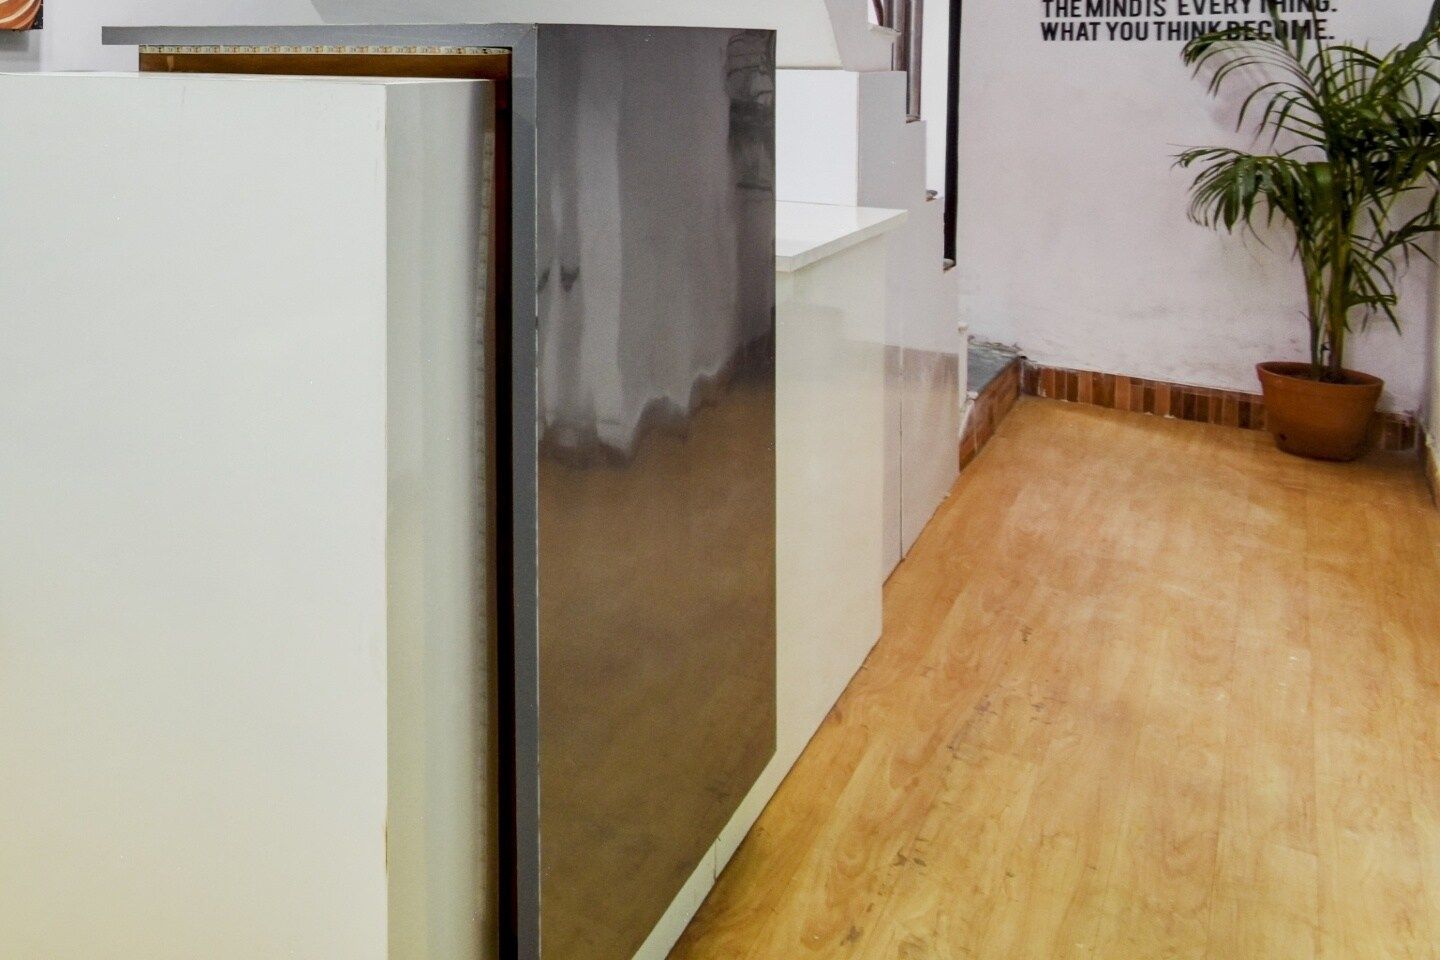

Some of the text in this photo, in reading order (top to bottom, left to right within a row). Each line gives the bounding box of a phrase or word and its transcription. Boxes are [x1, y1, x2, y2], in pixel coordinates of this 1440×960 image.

[1042, 0, 1082, 18] THE
[1040, 22, 1101, 41] WHAT
[1106, 21, 1149, 41] YOU
[1153, 20, 1221, 41] THINK
